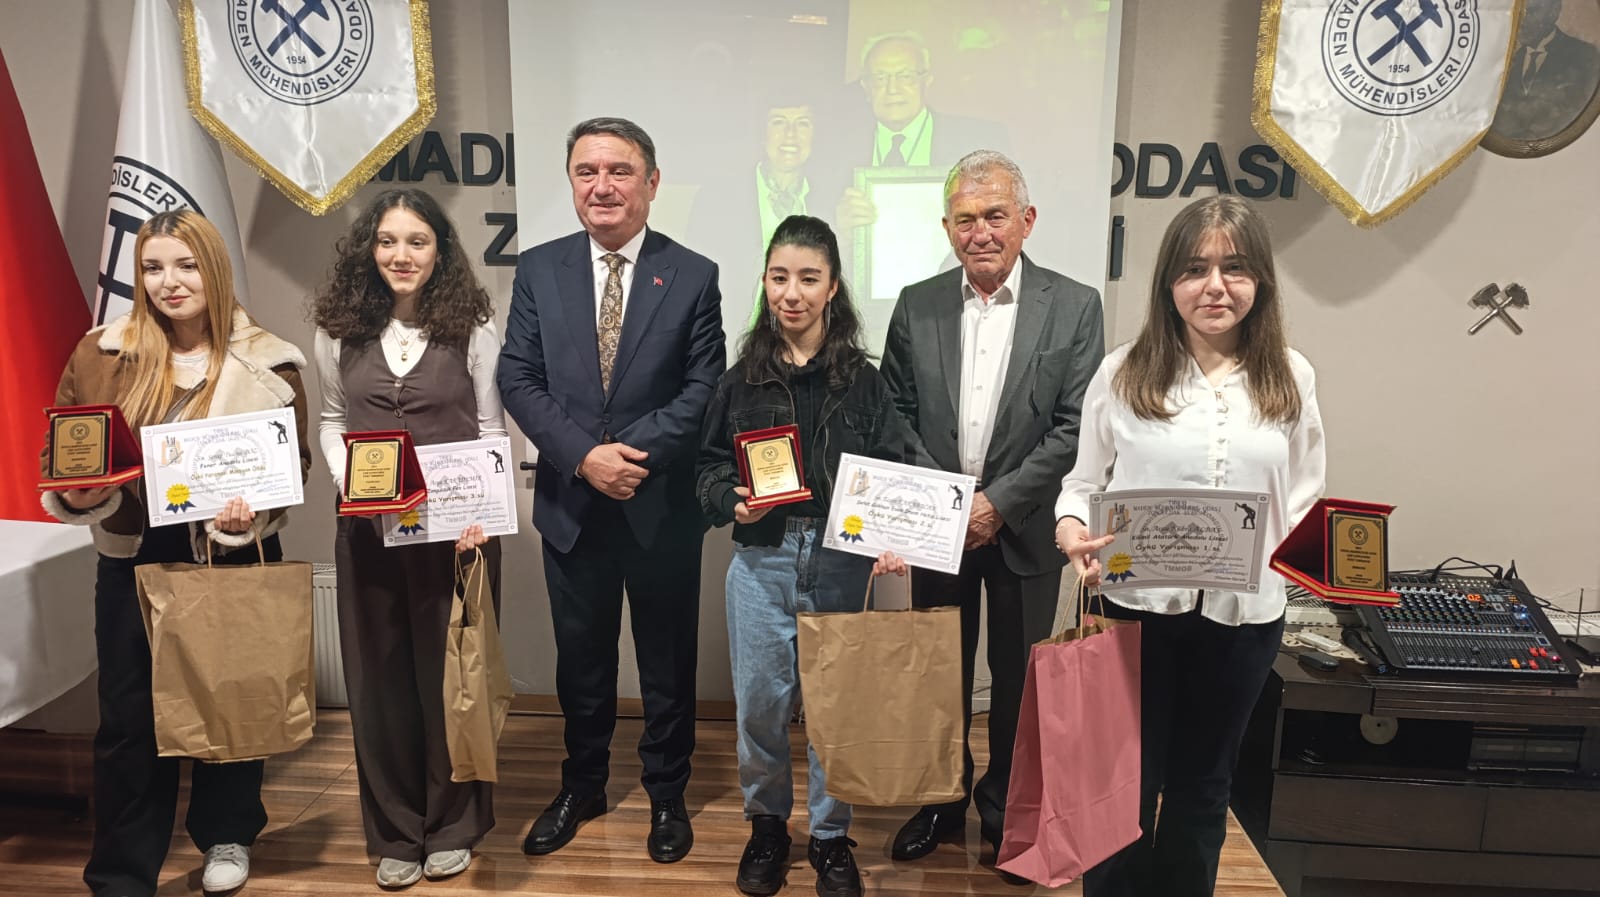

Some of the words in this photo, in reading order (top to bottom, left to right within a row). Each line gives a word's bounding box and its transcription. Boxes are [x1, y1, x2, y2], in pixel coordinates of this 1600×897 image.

[249, 48, 359, 96] MÜHENDİSLERİ
[342, 0, 363, 40] ODA
[286, 55, 307, 65] 1954
[1339, 57, 1461, 105] MÜHENDİSLERİ
[1388, 64, 1410, 74] 1954
